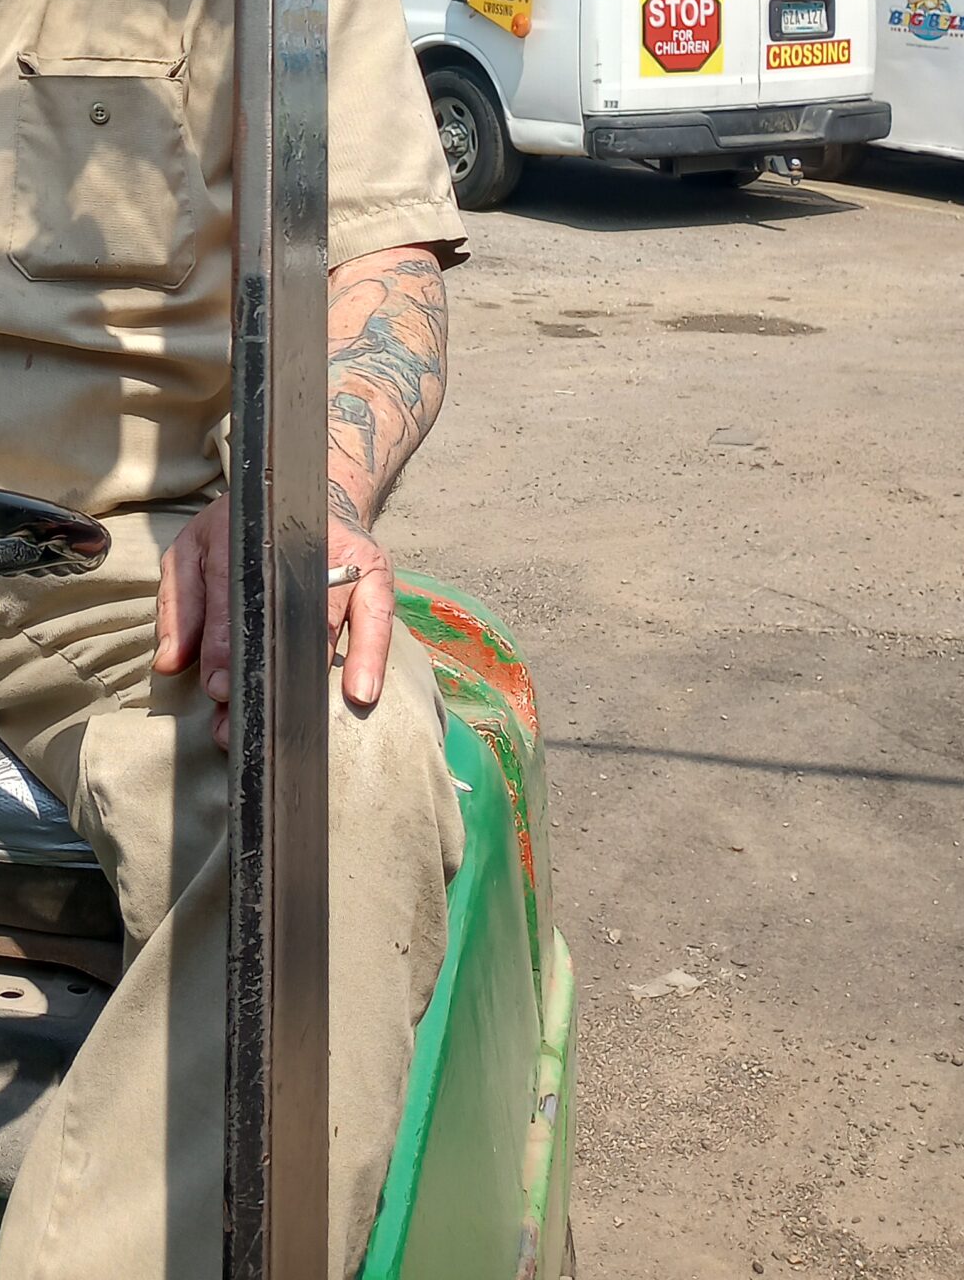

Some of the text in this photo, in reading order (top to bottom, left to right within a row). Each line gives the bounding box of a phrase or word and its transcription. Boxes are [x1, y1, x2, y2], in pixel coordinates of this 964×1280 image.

[483, 1, 514, 17] CROSSING
[889, 9, 924, 27] BIG
[672, 29, 693, 42] FOR
[654, 39, 710, 56] CHILDREN
[768, 40, 849, 68] CROSSING
